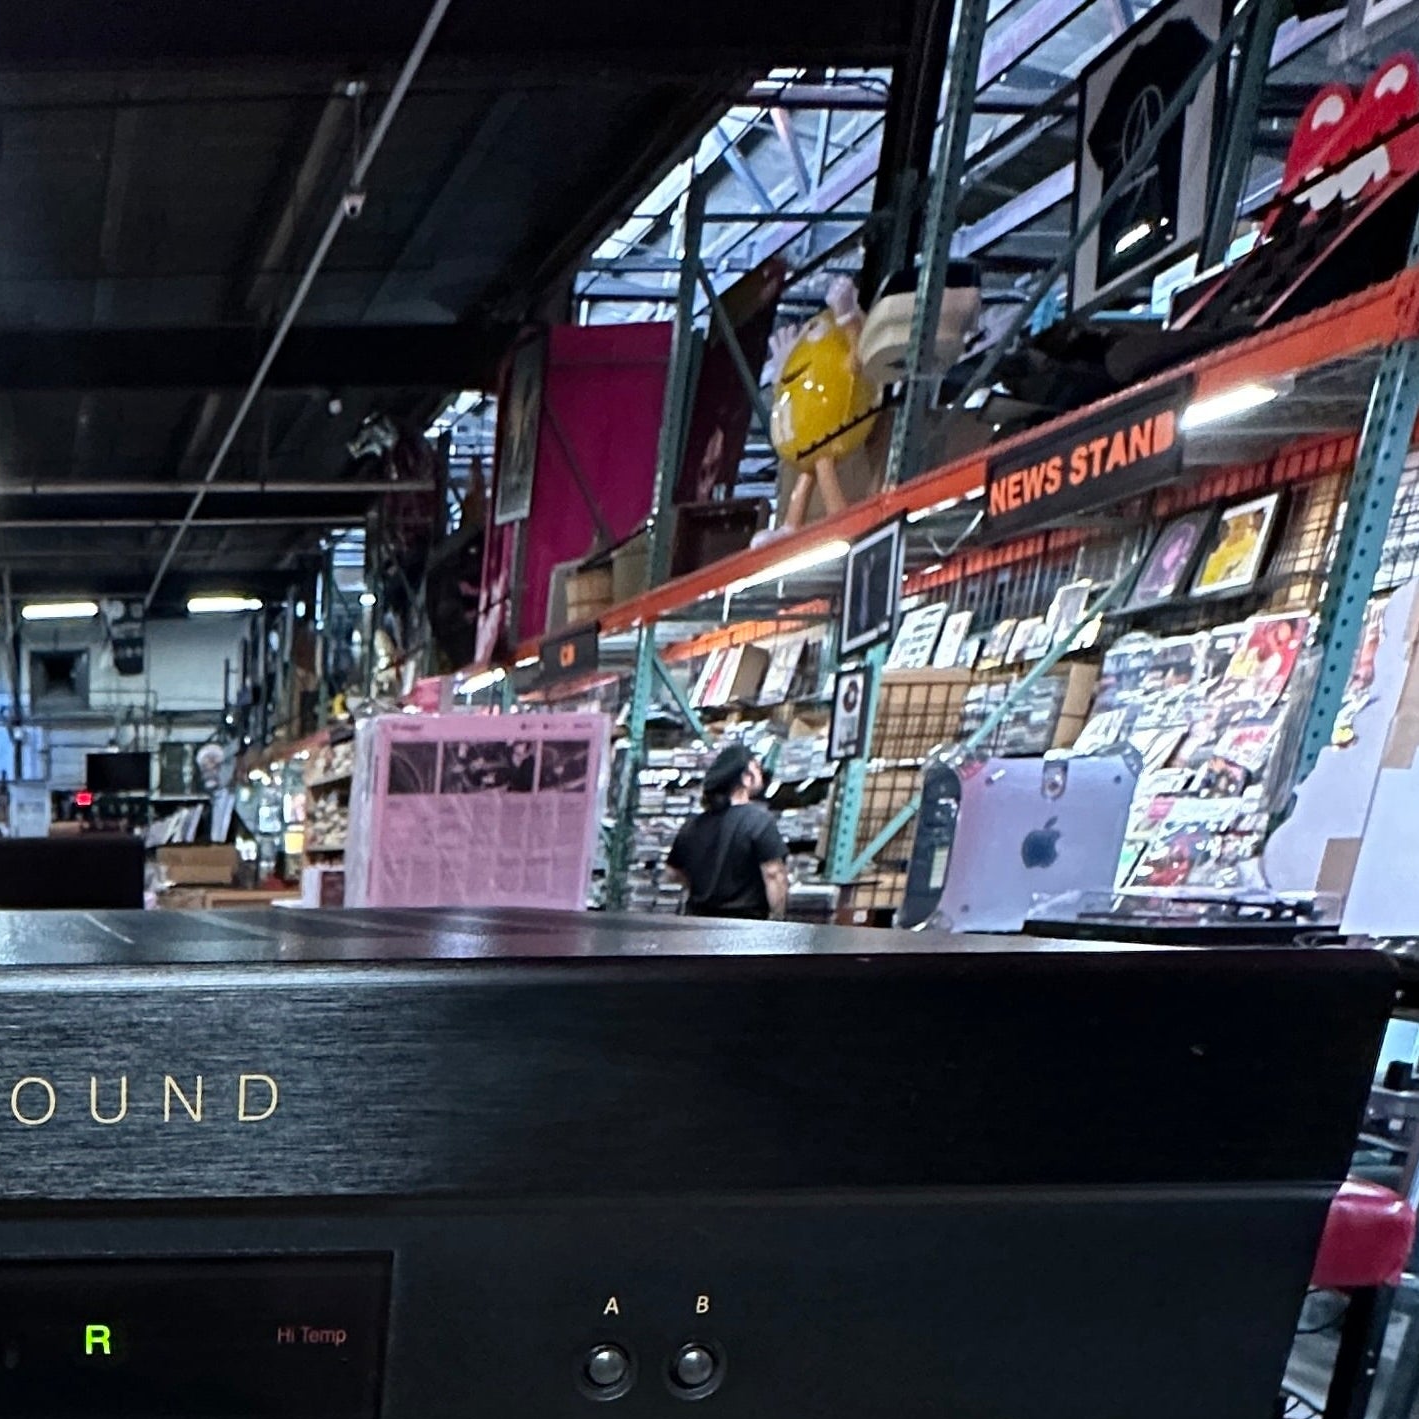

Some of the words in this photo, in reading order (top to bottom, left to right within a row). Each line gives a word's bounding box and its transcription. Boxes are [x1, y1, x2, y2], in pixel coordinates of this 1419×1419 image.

[989, 455, 1063, 517] NEWS
[1069, 409, 1175, 486] STAND
[603, 1296, 620, 1315] A
[695, 1295, 710, 1314] B
[84, 1324, 111, 1355] R
[276, 1327, 295, 1343] Hi
[302, 1326, 347, 1347] Temp
